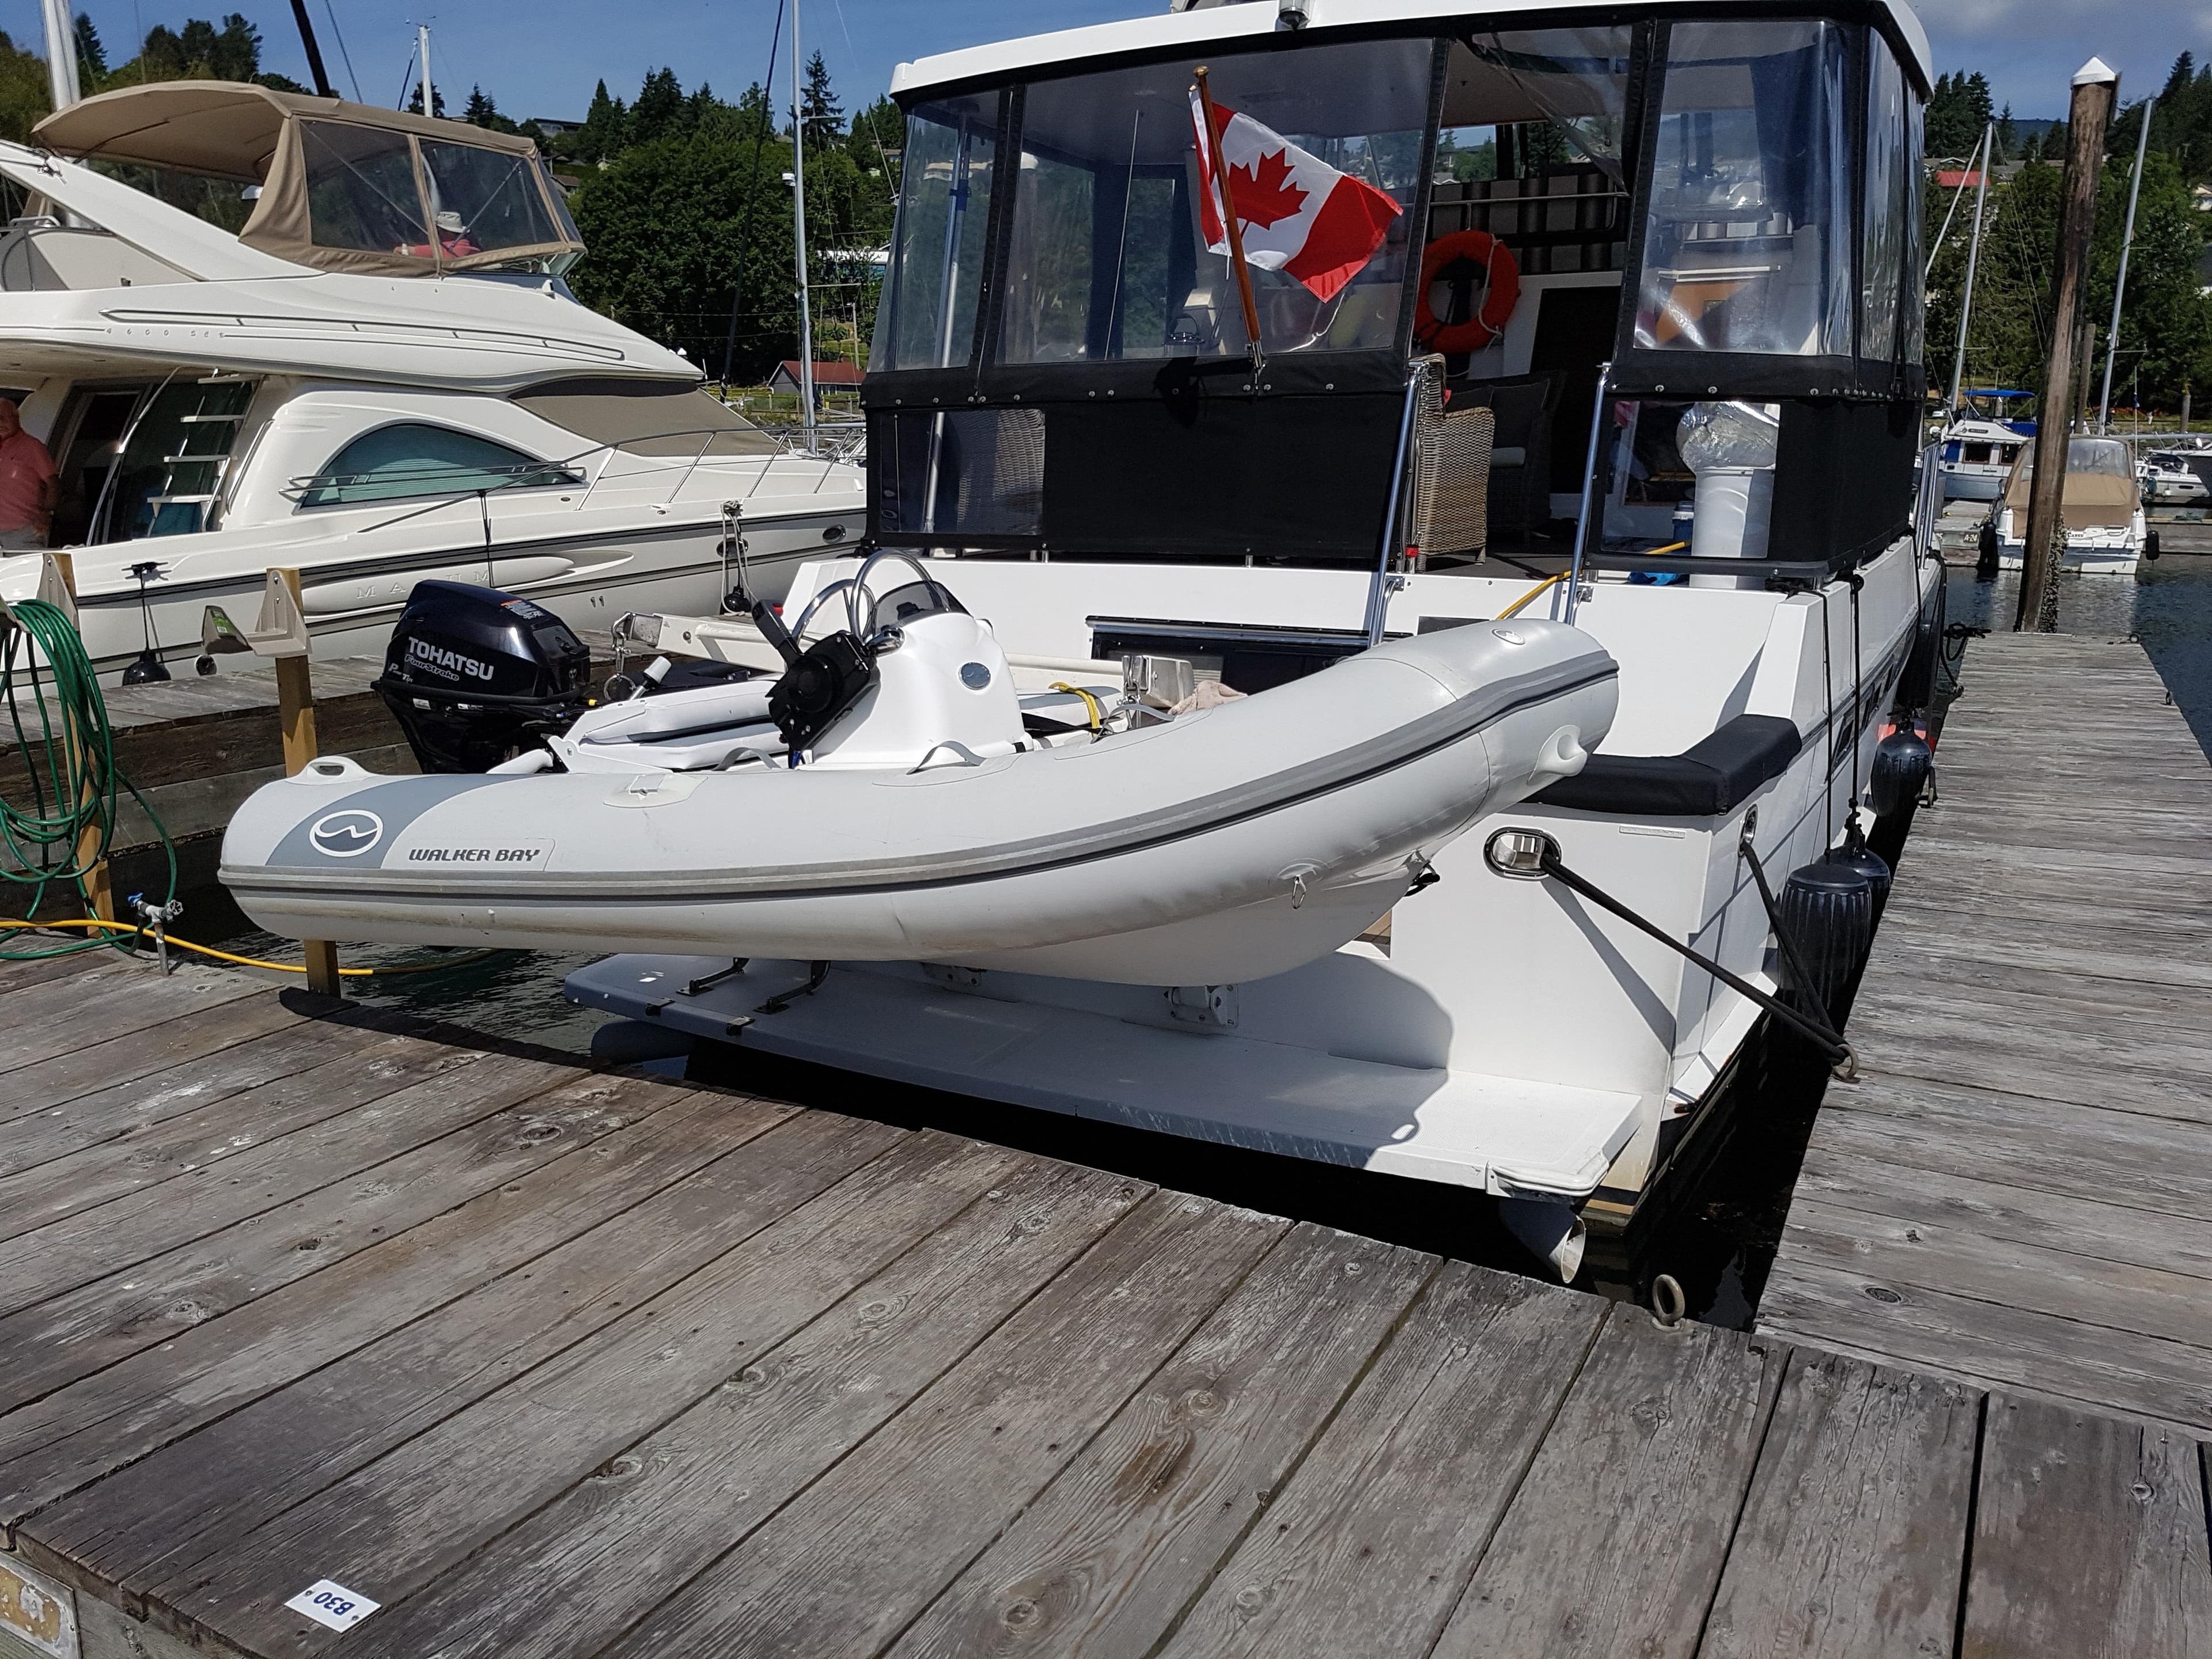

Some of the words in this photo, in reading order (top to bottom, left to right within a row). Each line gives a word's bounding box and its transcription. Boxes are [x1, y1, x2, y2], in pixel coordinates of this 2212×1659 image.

[357, 571, 490, 599] MAUM
[404, 654, 460, 681] FourStroke
[408, 636, 494, 680] TOHATSU
[408, 849, 491, 862] WALKER
[494, 849, 540, 862] BAY
[313, 1592, 357, 1616] B30
